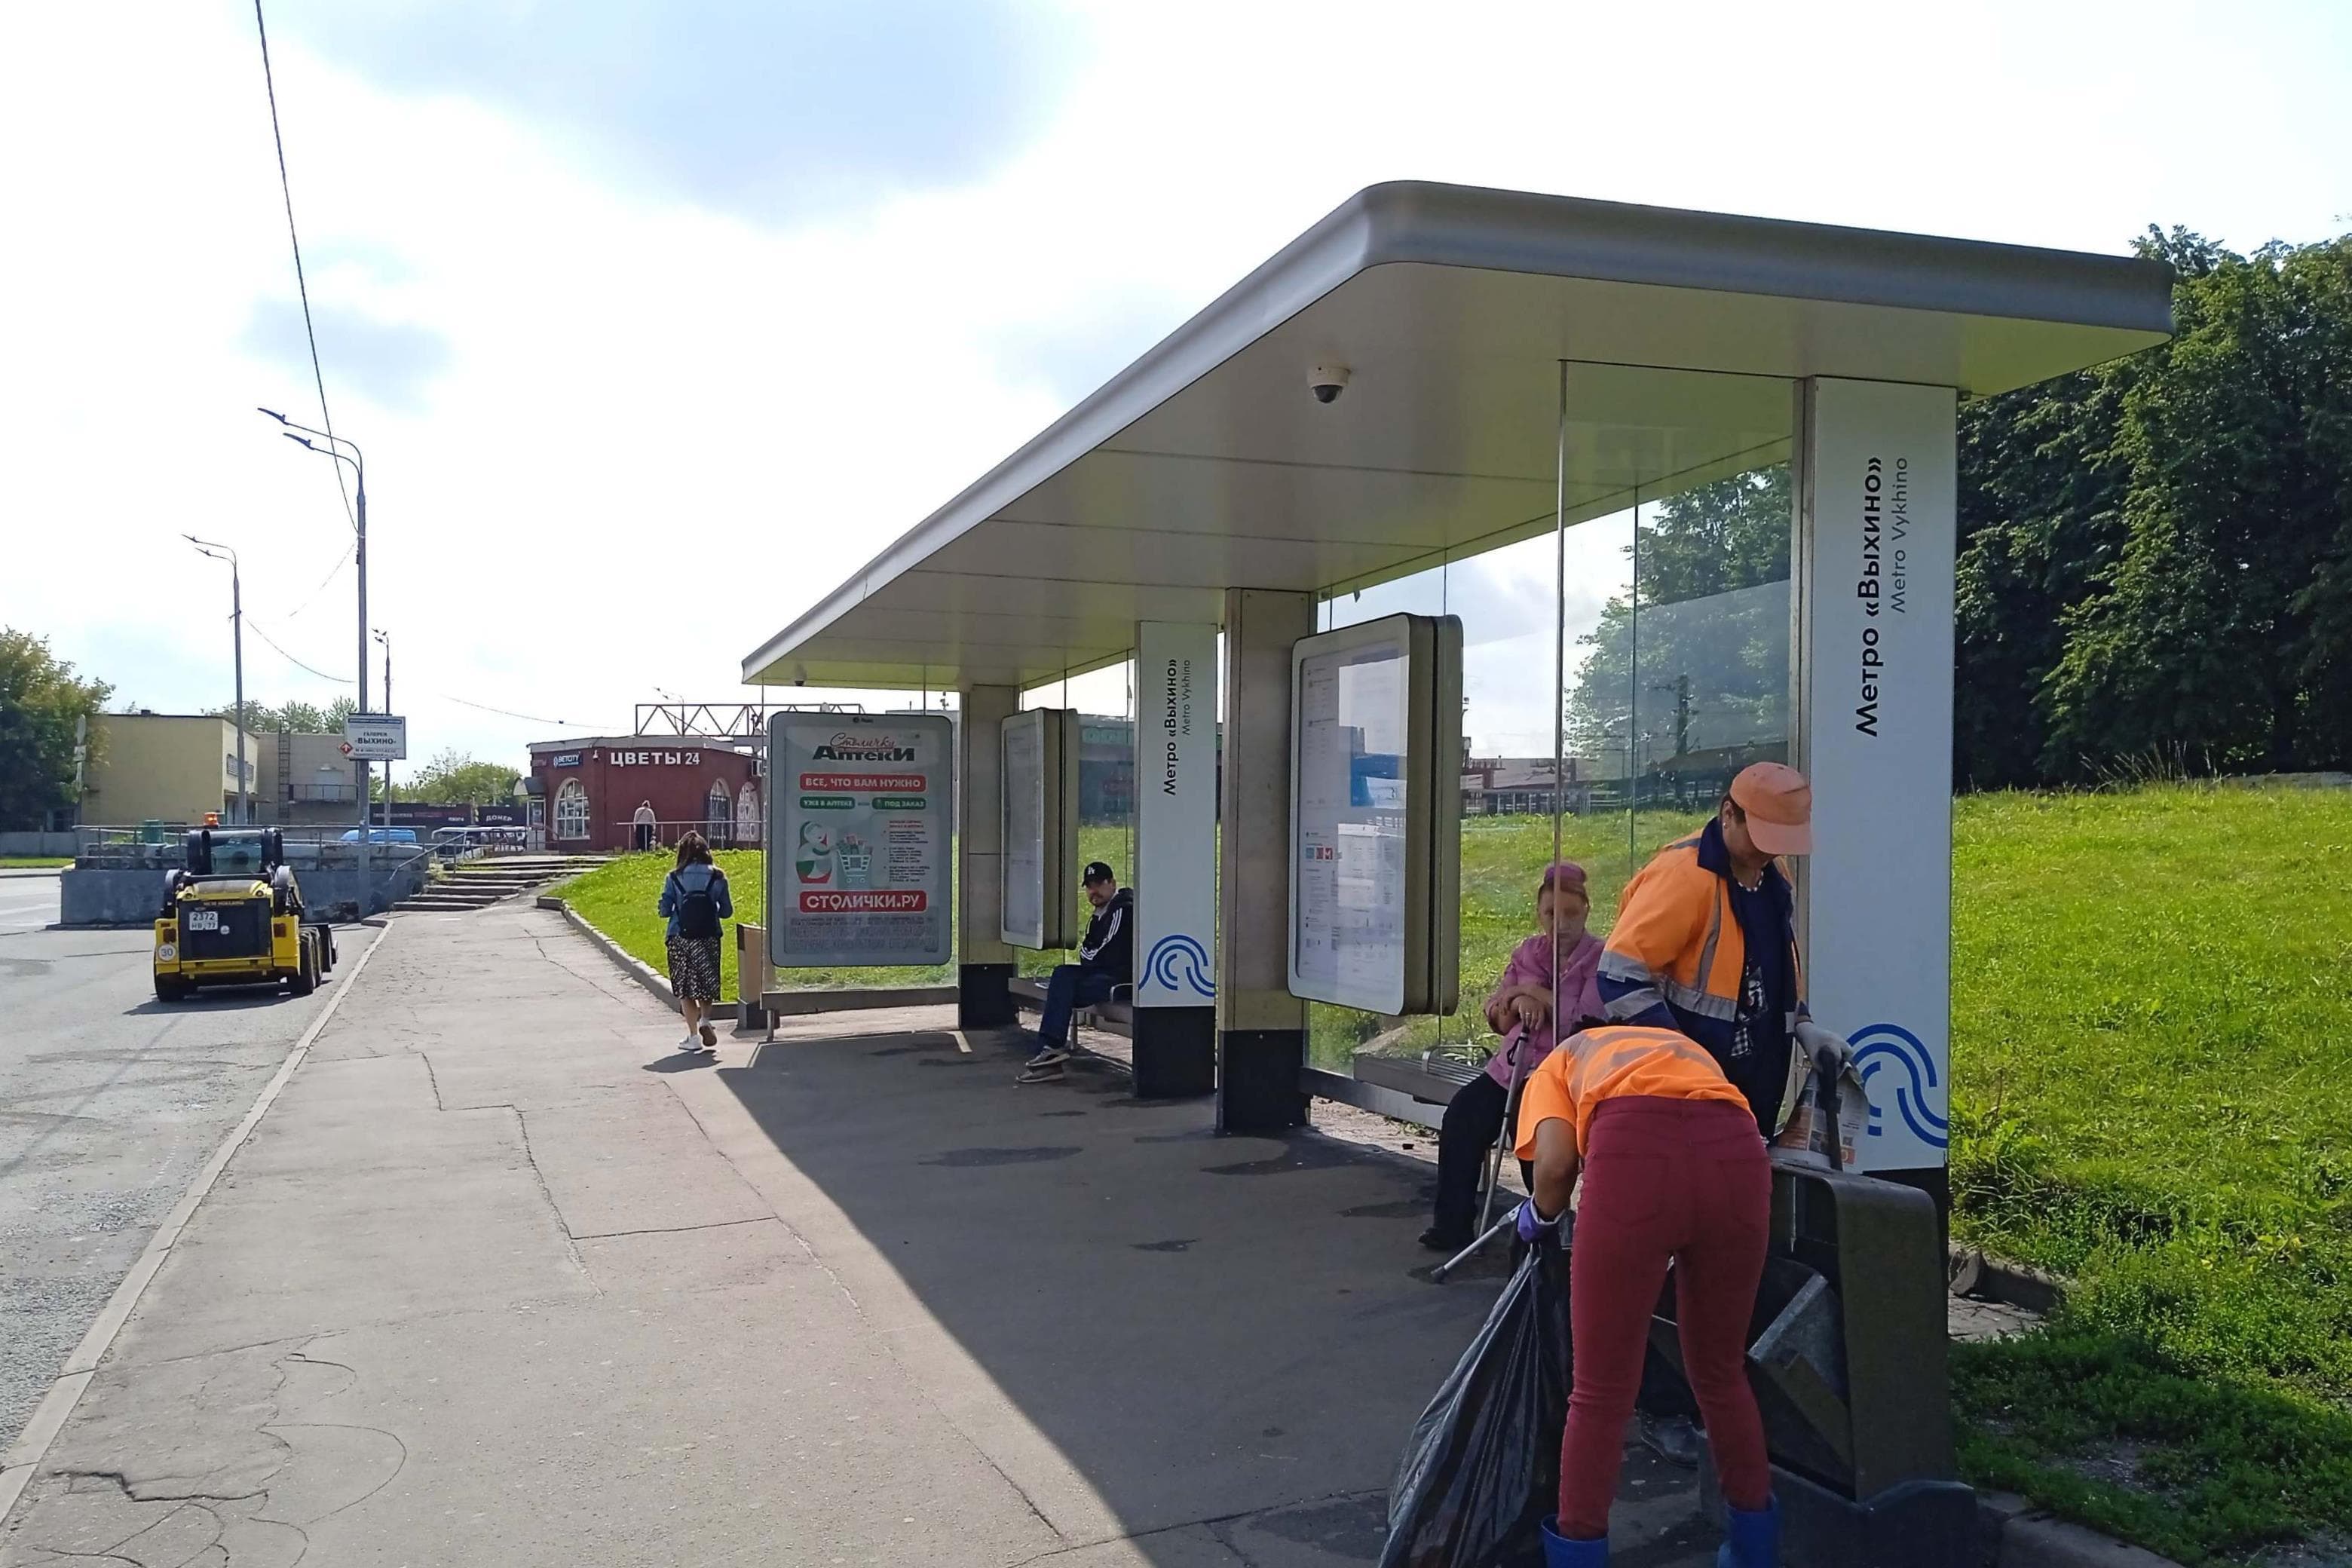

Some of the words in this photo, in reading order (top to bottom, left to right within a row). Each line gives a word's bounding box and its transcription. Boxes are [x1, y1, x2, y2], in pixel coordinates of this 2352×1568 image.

[1891, 458, 1909, 541] Vykhino
[1857, 457, 1882, 617] «Выхино»
[1891, 549, 1906, 613] Metro
[1164, 658, 1177, 737] «Выхино»
[1182, 660, 1192, 700] Vykhino
[1856, 628, 1883, 737] Метро
[1182, 704, 1190, 736] Metro
[610, 752, 681, 767] ЦВЕТЫ
[685, 752, 700, 765] 24
[1163, 743, 1178, 795] Метро
[805, 777, 828, 788] ВСЕ,
[831, 778, 851, 787] ЧТО
[854, 778, 877, 787] ВАМ
[880, 779, 920, 788] НУЖНО
[193, 912, 215, 921] 2372
[807, 894, 920, 911] СТОЛИЧКИ.РУ
[161, 948, 173, 957] 30
